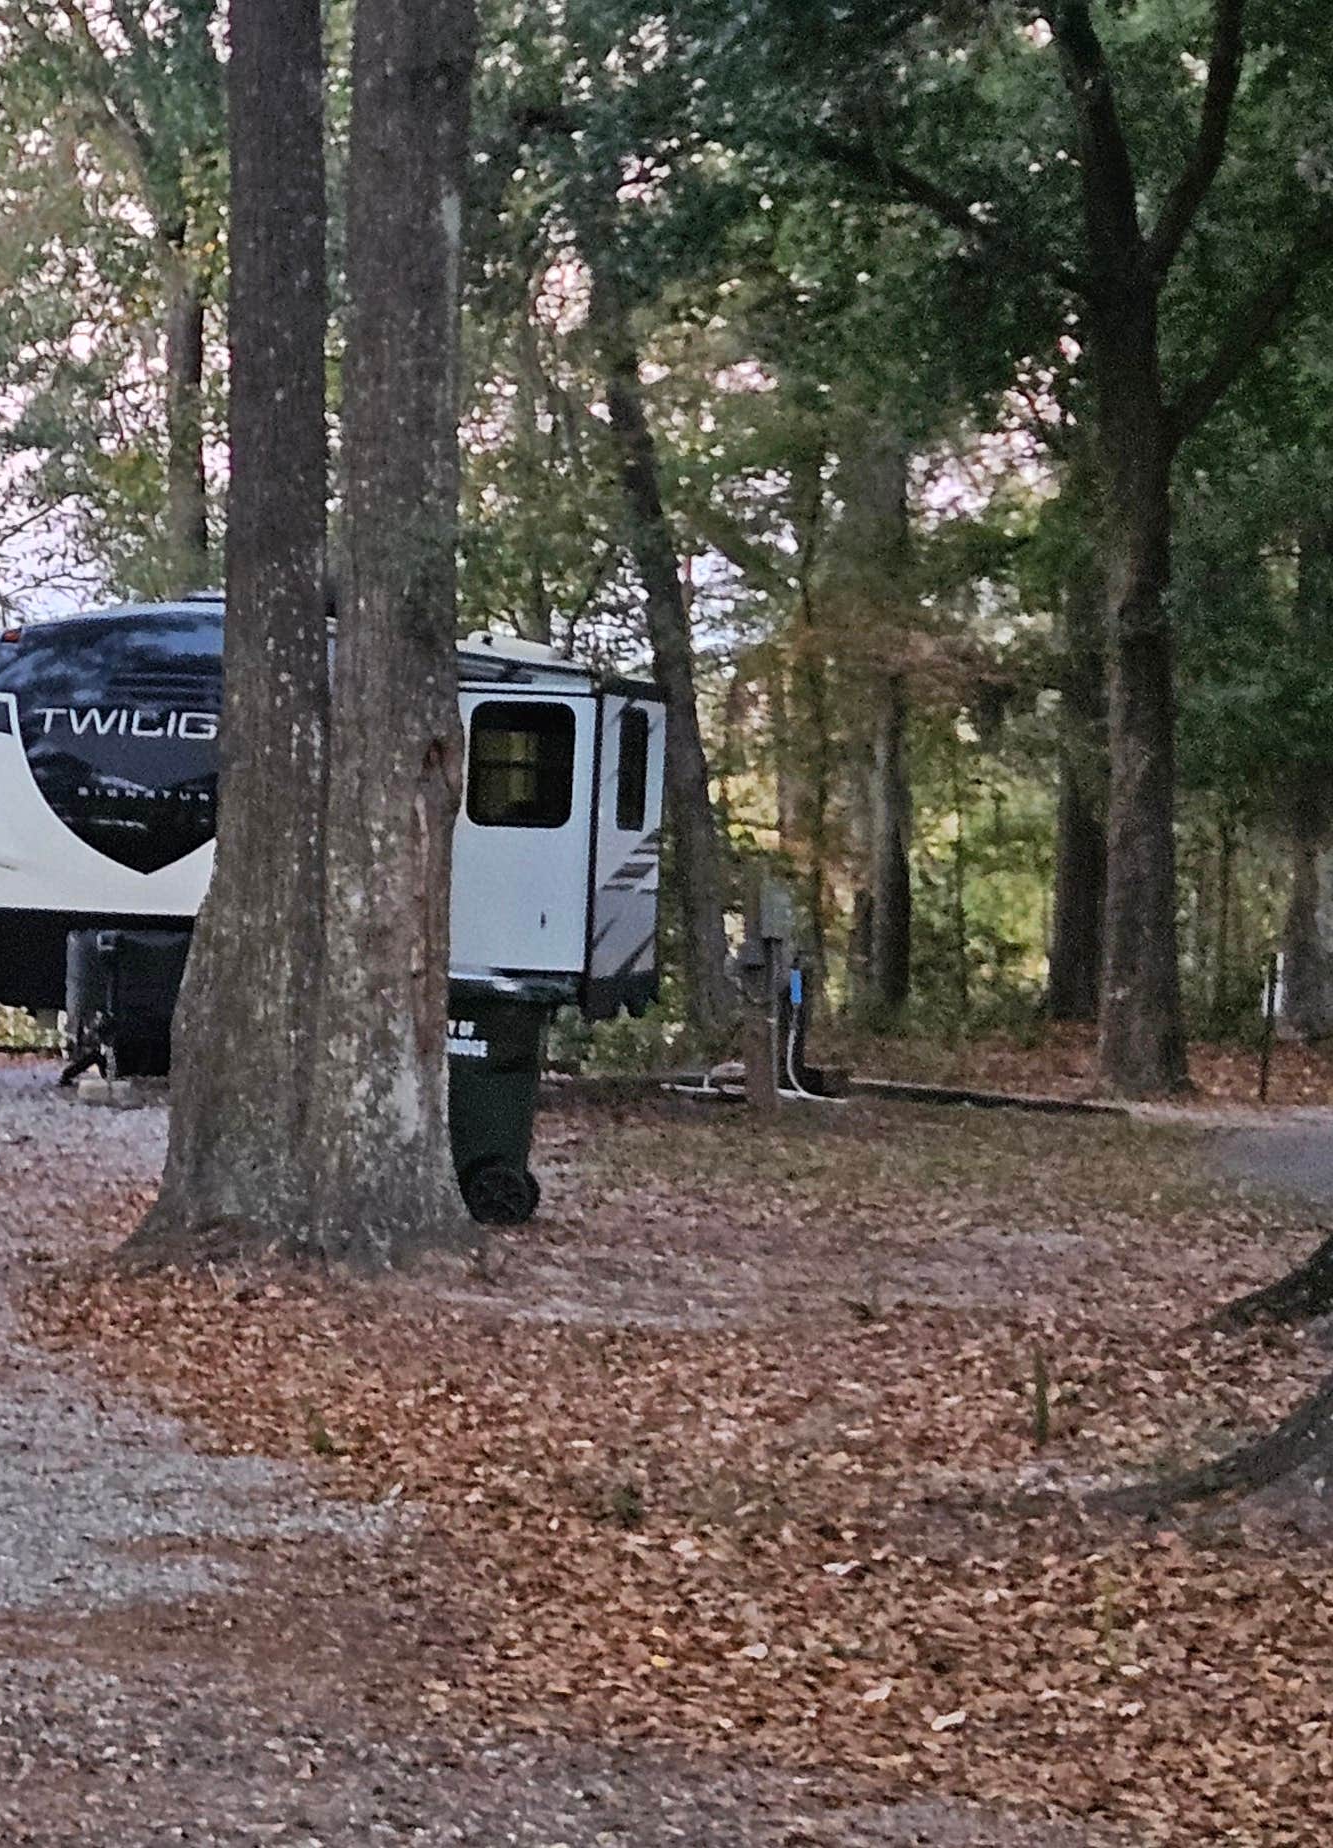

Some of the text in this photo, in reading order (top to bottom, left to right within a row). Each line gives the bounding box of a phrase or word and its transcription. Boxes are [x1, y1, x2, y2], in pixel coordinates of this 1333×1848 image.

[33, 708, 219, 739] TWILIG
[77, 787, 209, 801] SIGNATUR
[446, 1019, 456, 1036] Y
